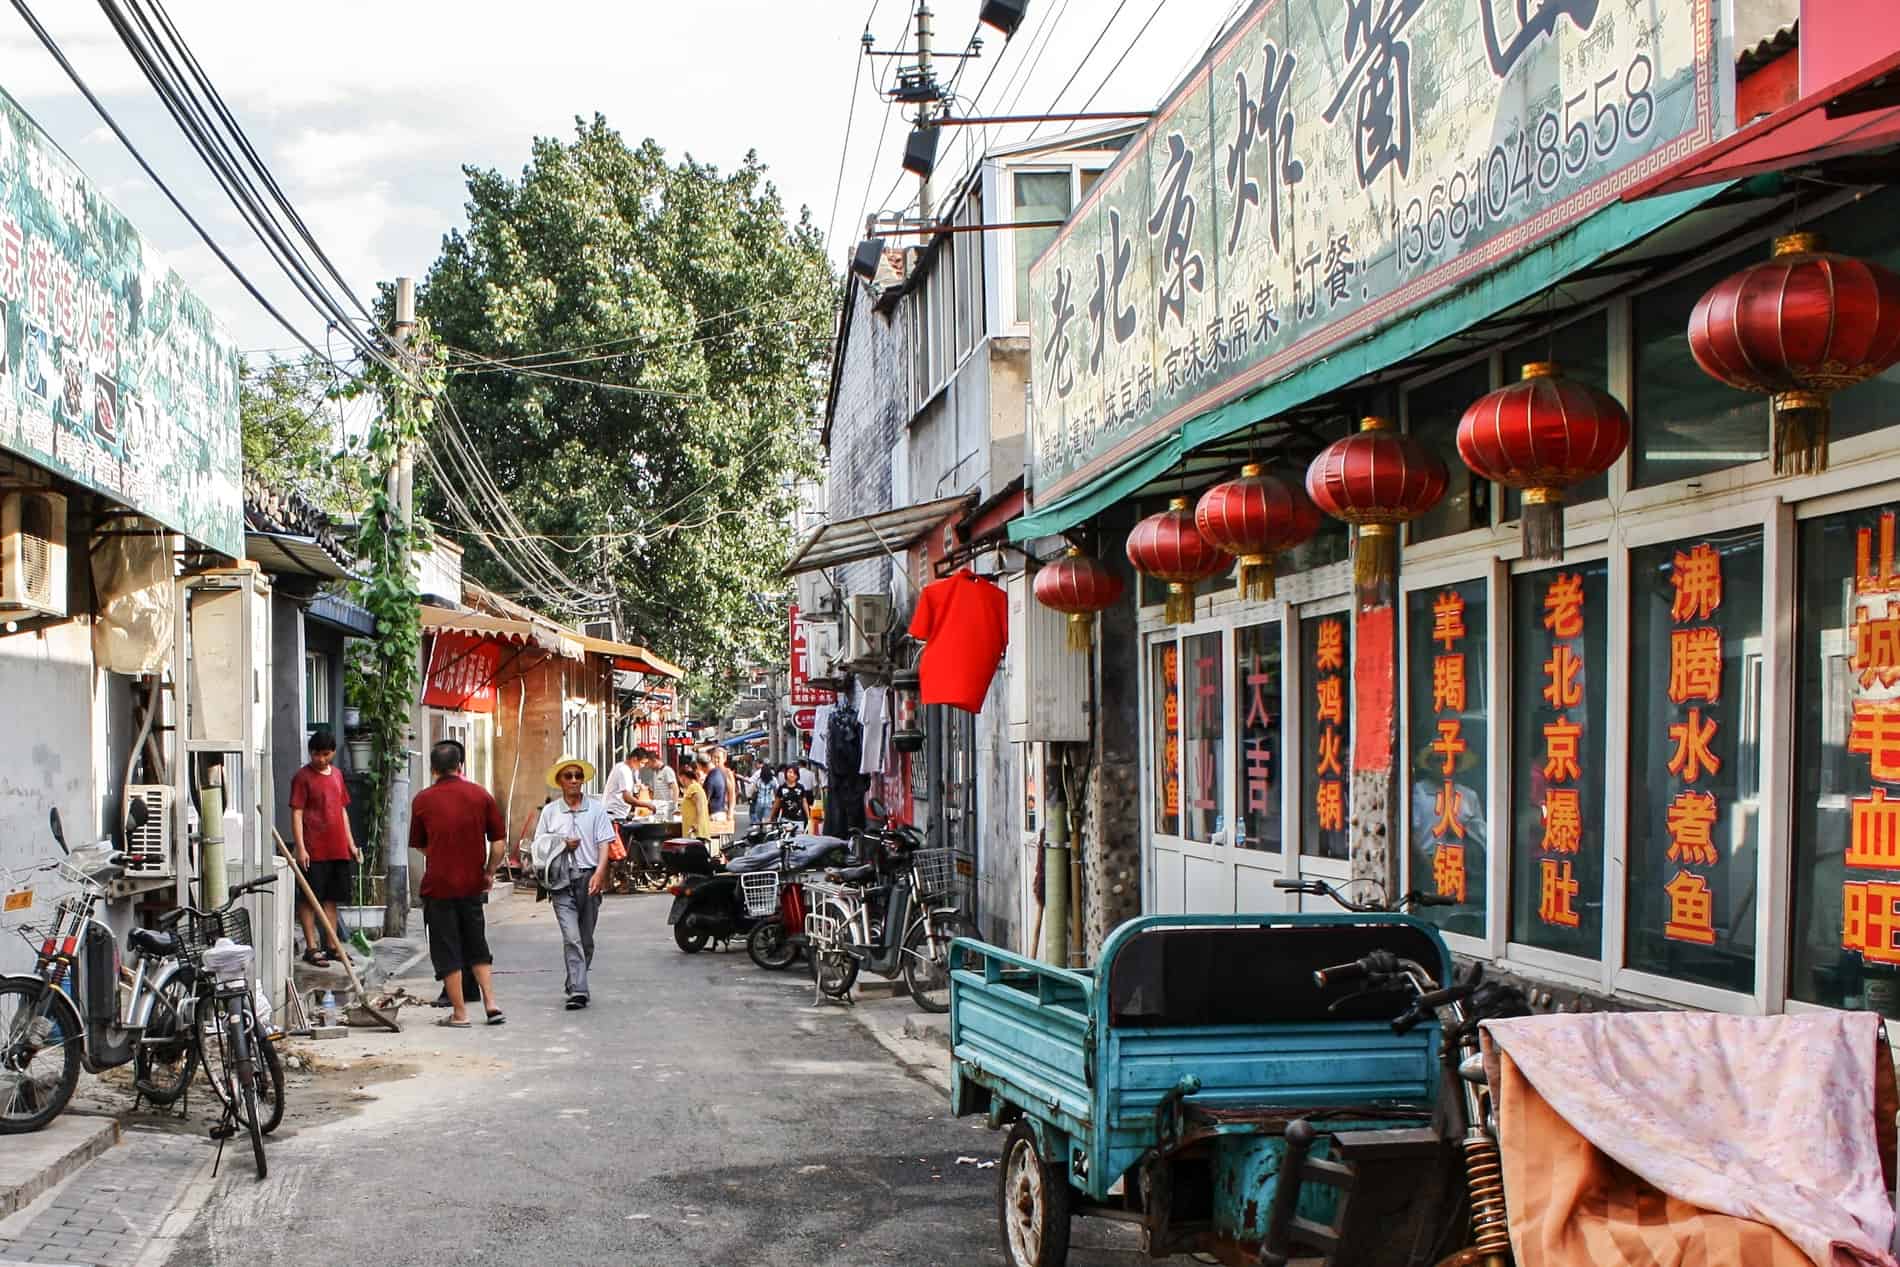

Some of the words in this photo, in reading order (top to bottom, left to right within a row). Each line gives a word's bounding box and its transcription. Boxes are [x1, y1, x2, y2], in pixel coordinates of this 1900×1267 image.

[1162, 278, 1279, 396] 京味家常菜
[1391, 53, 1655, 272] 13681048558
[1194, 656, 1217, 811] 开业
[1246, 654, 1271, 816] 大吉
[1316, 618, 1344, 832] 柴鸡火锅
[1537, 572, 1584, 928] 老北京爆肚
[1663, 543, 1722, 945] 沸腾水煮鱼
